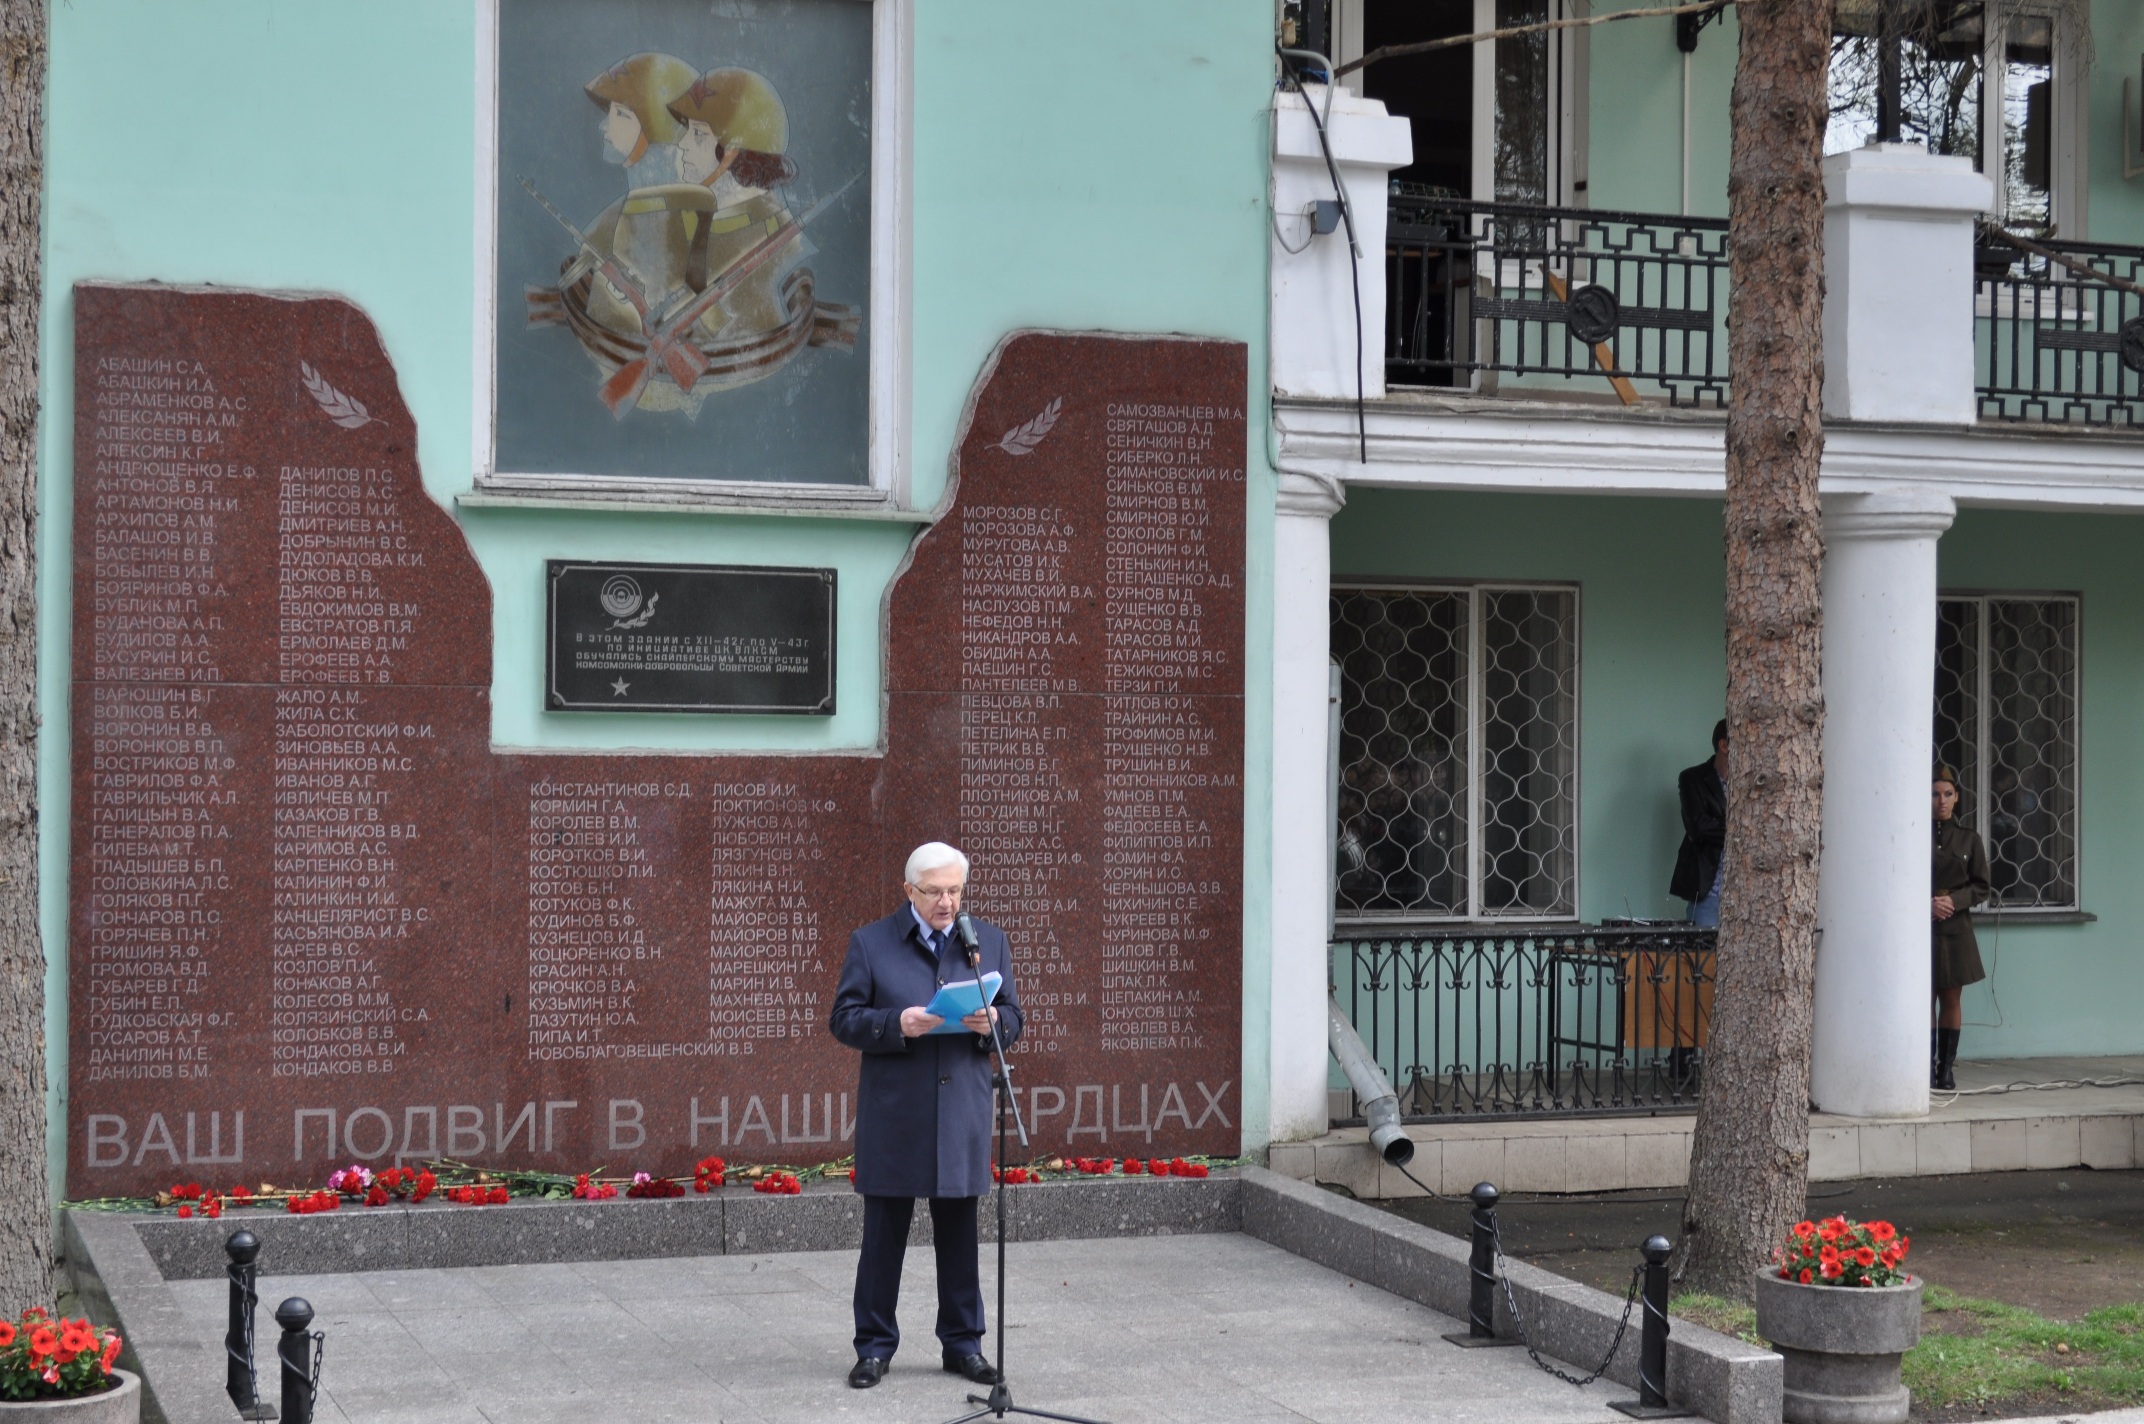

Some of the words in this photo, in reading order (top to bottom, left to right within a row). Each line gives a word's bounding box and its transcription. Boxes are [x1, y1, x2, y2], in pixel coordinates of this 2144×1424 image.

[98, 358, 171, 373] АБАШИН
[97, 393, 214, 408] АБРАМЕНКОВ
[1107, 404, 1213, 420] САМОЗВАНЦЕВ
[1107, 435, 1183, 449] СЕНИЧКИН
[97, 461, 222, 478] АНДРЮЩЕНКО
[279, 467, 360, 483] ДАНИЛОВ
[1107, 466, 1215, 481] СИМАНОВСКИЙ
[96, 496, 204, 510] АРТАМОНОВ
[963, 522, 1045, 536] МОРОЗОВА
[96, 530, 180, 544] БАЛАШОВ
[1106, 542, 1176, 555] СОЛОНИН
[280, 552, 392, 568] ДУДОЛАДОВА
[1106, 571, 1203, 586] СТЕПАШЕНКО
[95, 582, 192, 595] БОЯРИНОВ
[963, 583, 1066, 598] НАРЖИМСКИЙ
[281, 602, 384, 617] ЕВДОКИМОВ
[962, 616, 1032, 629] НЕФЕДОВ
[576, 633, 582, 642] В
[629, 635, 678, 644] ЗДАНИИ
[962, 631, 1050, 645] НИКАНДРОВ
[629, 644, 709, 653] ИНИЦИАТИВЕ
[715, 646, 729, 654] ЦК
[735, 646, 777, 655] ВЛКСМ
[1105, 649, 1198, 662] ТАТАРНИКОВ
[280, 653, 359, 666] ЕРОФЕЕВ
[576, 652, 641, 661] ОБУЧАЛИСЬ
[647, 652, 733, 662] СНАЙПЕРСКОМУ
[739, 656, 808, 664] МАСТЕРСТВУ
[962, 663, 1025, 675] ПАЕШИН
[961, 695, 1031, 709] ПЕВЦОВА
[94, 705, 164, 719] ВОЛКОВ
[276, 707, 324, 721] ЖИЛА
[276, 722, 398, 738] ЗАБОЛОТСКИЙ
[961, 727, 1038, 739] ПЕТЕЛИНА
[1104, 728, 1184, 740] ТРОФИМОВ
[94, 757, 199, 771] ВОСТРИКОВ
[275, 758, 377, 771] ИВАННИКОВ
[1104, 774, 1206, 786] ТЮТЮННИКОВ
[531, 783, 659, 797] КОНСТАНТИНОВ
[713, 784, 765, 797] ЛИСОВ
[961, 790, 1049, 802] ПЛОТНИКОВ
[275, 808, 349, 821] КАЗАКОВ
[531, 816, 604, 830] КОРОЛЕВ
[1104, 821, 1181, 834] ФЕДОСЕЕВ
[94, 825, 195, 838] ГЕНЕРАЛОВ
[961, 837, 1033, 849] ПОЛОВЫХ
[93, 860, 189, 875] ГЛАДЫШЕВ
[275, 859, 362, 872] КАРПЕНКО
[530, 865, 623, 879] КОСТЮШКО
[712, 880, 773, 893] ЛЯКИНА
[1103, 882, 1195, 895] ЧЕРНЫШОВА
[92, 911, 185, 924] ГОНЧАРОВ
[274, 908, 397, 925] КАНЦЕЛЯРИСТ
[530, 915, 603, 929] КУДИНОВ
[712, 910, 788, 925] МАЙОРОВ
[529, 931, 613, 947] КУЗНЕЦОВ
[711, 926, 787, 942] МАЙОРОВ
[1103, 929, 1179, 941] ЧУРИНОВА
[529, 948, 630, 963] КОЦЮРЕНКО
[711, 961, 797, 974] МАРЕШКИН
[529, 980, 606, 994] КРЮЧКОВ
[711, 978, 764, 990] МАРИН
[710, 993, 784, 1007] МАХНЕВА
[274, 1006, 395, 1025] КОЛЯЗИНСКИЙ
[1102, 1006, 1164, 1020] ЮНУСОВ
[91, 1013, 202, 1030] ГУДКОВСКАЯ
[529, 1013, 600, 1028] ЛАЗУТИН
[710, 1026, 785, 1039] МОИСЕЕВ
[1101, 1036, 1176, 1050] ЯКОВЛЕВА
[273, 1043, 373, 1060] КОНДАКОВА
[529, 1041, 724, 1061] НОВОБЛАГОВЕЩЕНСКИЙ
[90, 1065, 172, 1082] ДАНИЛОВ
[87, 1110, 243, 1168] ВАШ
[294, 1100, 578, 1164] ПОДВИГ
[608, 1099, 646, 1150] В
[992, 1081, 1233, 1144] ЕРДЦАХ
